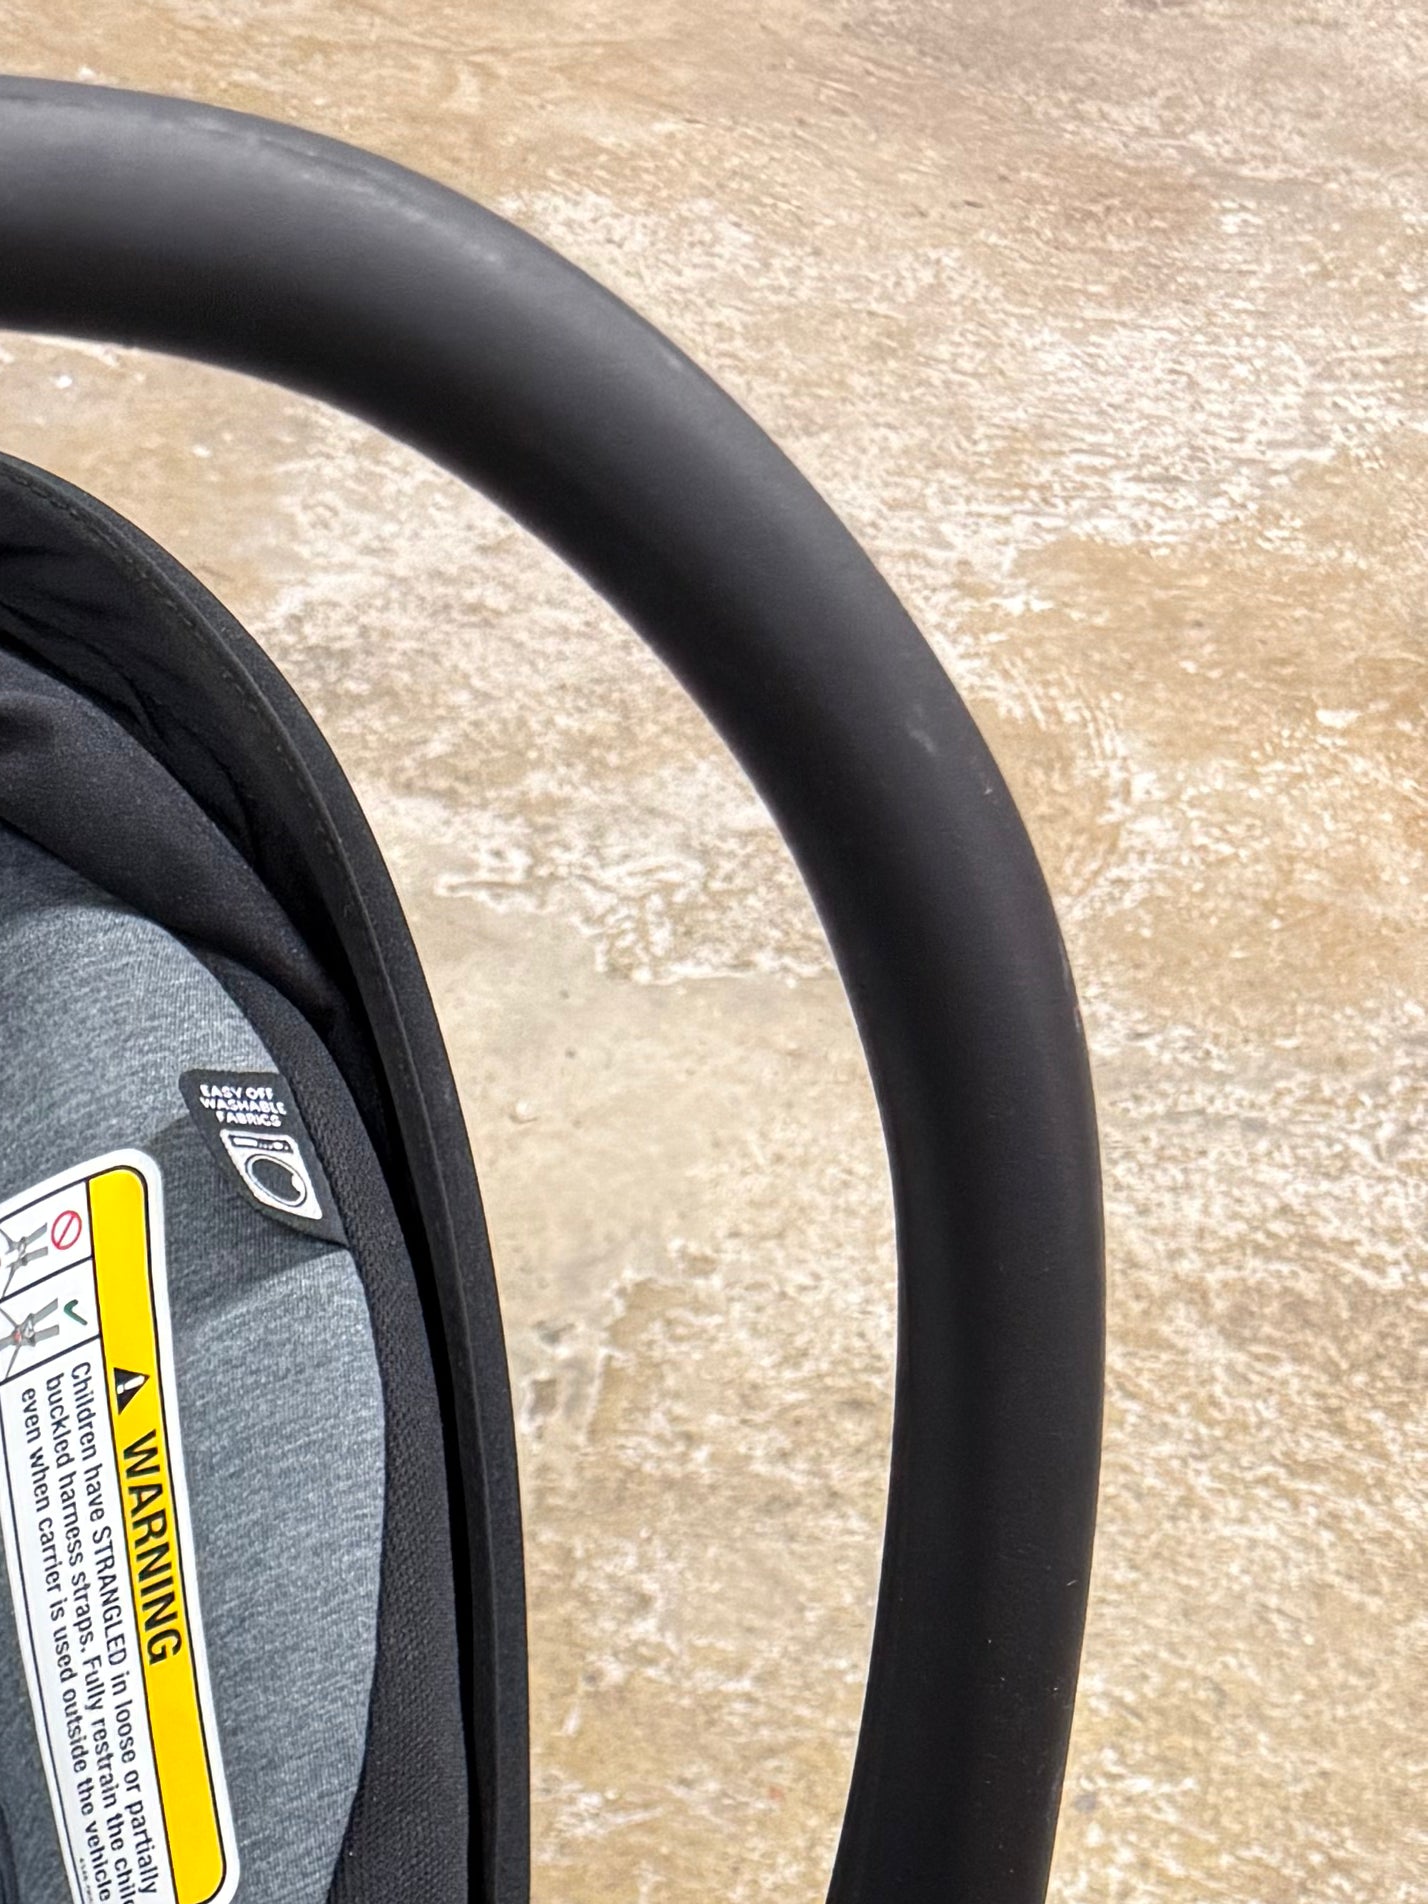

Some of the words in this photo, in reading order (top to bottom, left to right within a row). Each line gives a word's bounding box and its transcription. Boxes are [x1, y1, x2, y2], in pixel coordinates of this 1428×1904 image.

[200, 1084, 242, 1099] EASY
[245, 1087, 273, 1100] OFF
[200, 1097, 287, 1115] WASHABLE
[215, 1111, 281, 1127] FABRICS
[22, 1387, 42, 1445] even
[46, 1372, 76, 1470] buckled
[71, 1361, 97, 1462] Children
[29, 1445, 51, 1513] when
[83, 1463, 106, 1523] have
[58, 1470, 85, 1568] harness
[123, 1429, 183, 1666] WARNING
[37, 1516, 63, 1593] carrier
[49, 1598, 67, 1623] is
[71, 1573, 94, 1654] straps.
[92, 1525, 127, 1667] STRANGLED
[52, 1623, 78, 1684] used
[82, 1653, 107, 1712] Fully
[110, 1670, 131, 1696] in
[62, 1688, 88, 1774] outside
[114, 1698, 137, 1764] loose
[91, 1717, 120, 1810] restrain
[123, 1769, 142, 1794] or
[76, 1778, 95, 1816] the
[106, 1814, 125, 1852] the
[125, 1799, 159, 1895] partially
